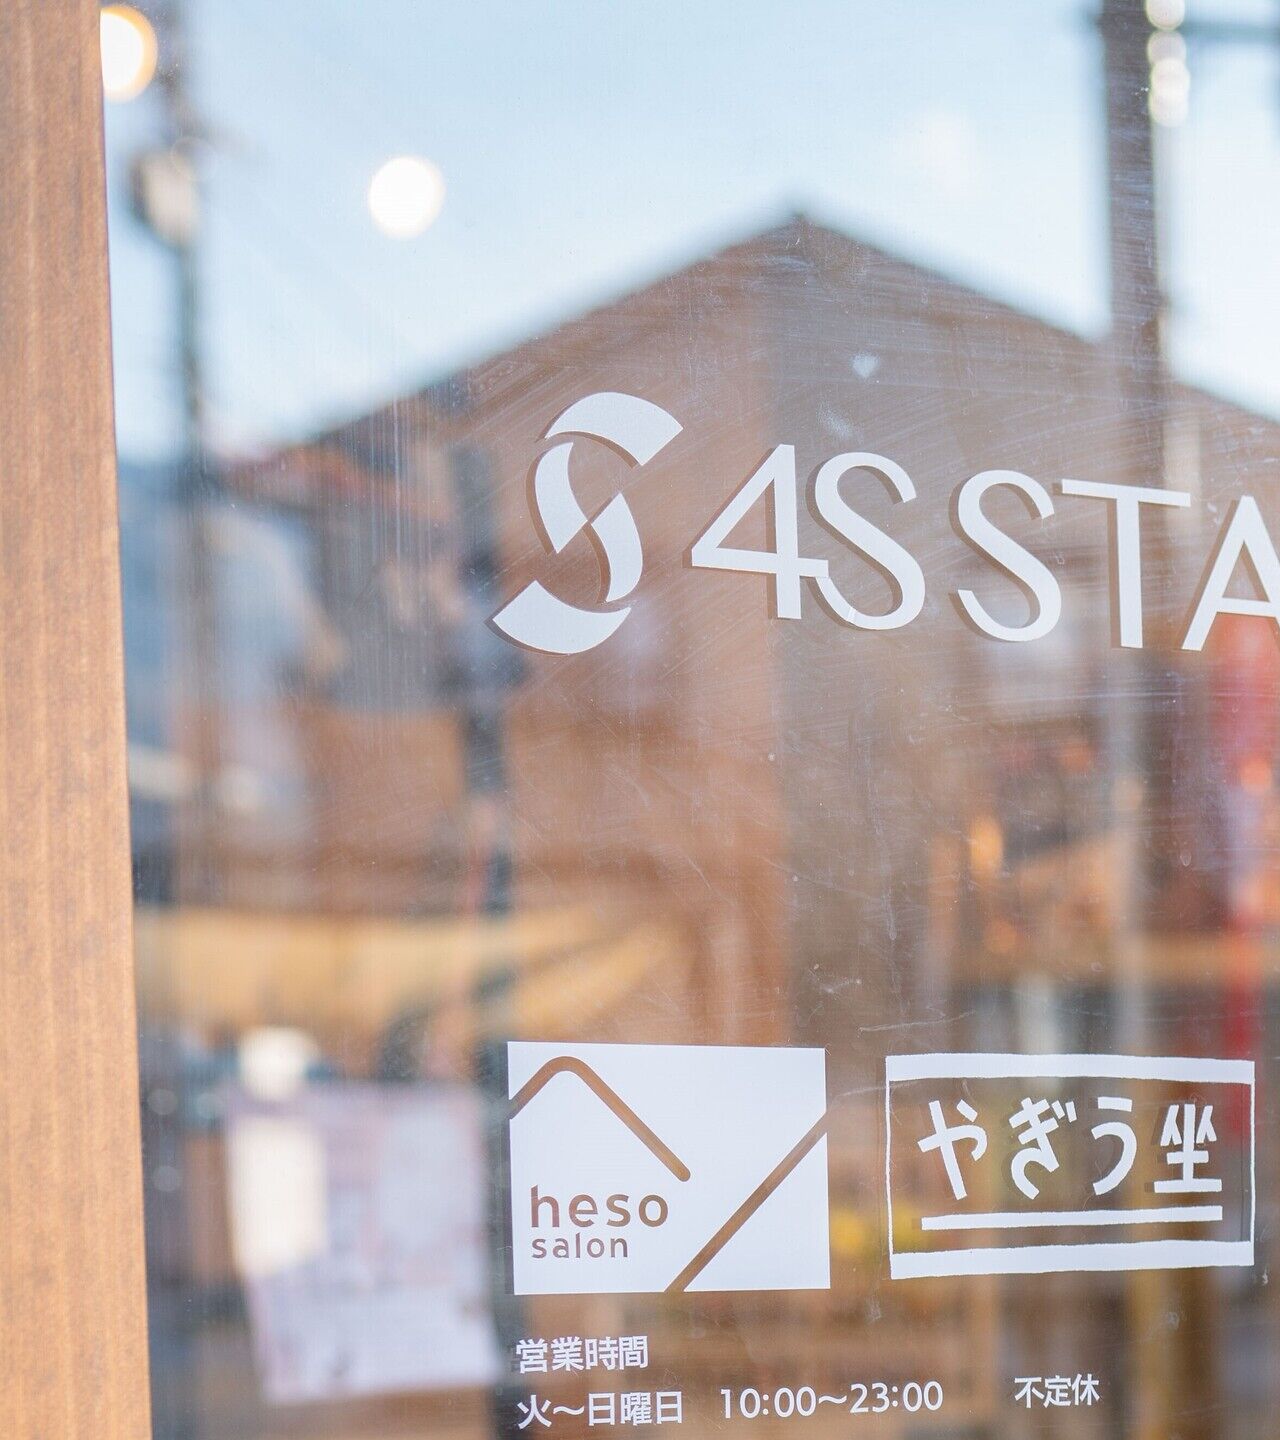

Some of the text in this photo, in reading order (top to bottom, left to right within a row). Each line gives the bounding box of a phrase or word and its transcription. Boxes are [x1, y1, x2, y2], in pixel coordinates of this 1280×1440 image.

[691, 444, 926, 631] 4S
[917, 1096, 1223, 1200] やぎう坐
[530, 1185, 670, 1229] heso
[530, 1231, 630, 1260] salon
[516, 1335, 649, 1374] 営業時間
[1014, 1374, 1101, 1410] 不定休
